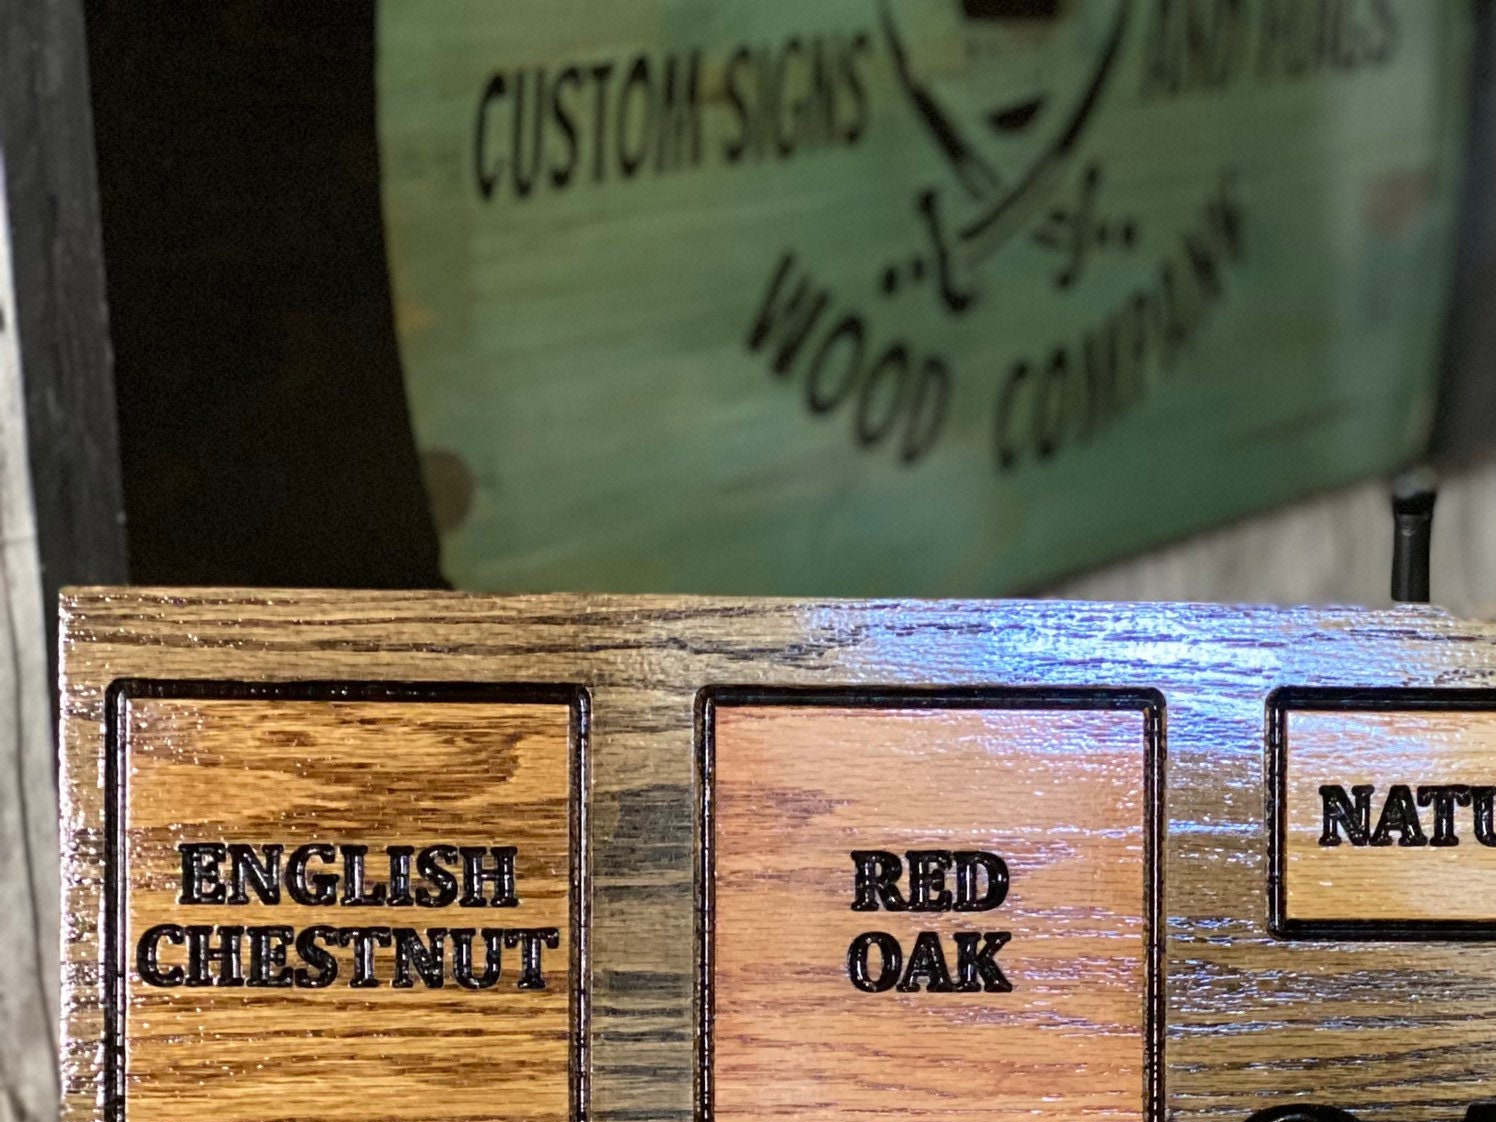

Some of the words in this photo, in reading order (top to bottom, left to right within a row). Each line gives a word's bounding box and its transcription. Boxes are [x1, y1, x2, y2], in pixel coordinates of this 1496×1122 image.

[473, 45, 705, 202] CUSTOM
[722, 29, 872, 163] SIGNS
[746, 246, 953, 467] WOOD
[178, 843, 518, 907] ENGLISH
[850, 849, 1009, 913] RED
[136, 924, 559, 989] CHESTNUT
[847, 930, 1012, 994] OAK
